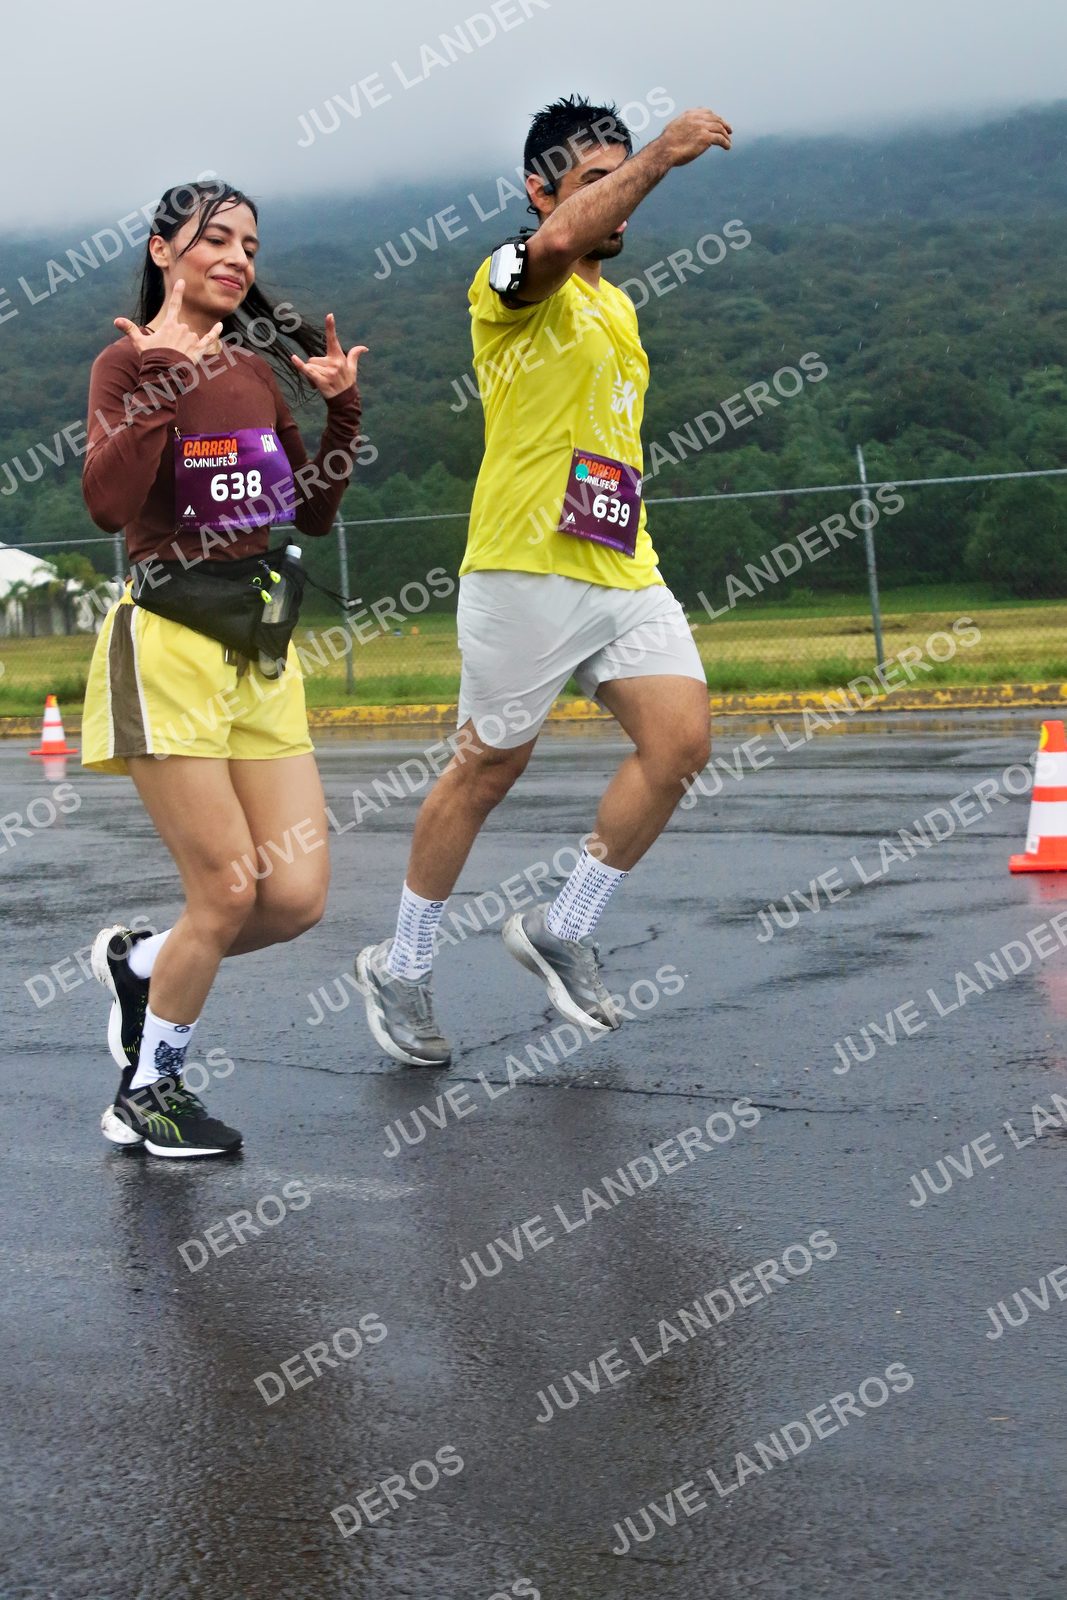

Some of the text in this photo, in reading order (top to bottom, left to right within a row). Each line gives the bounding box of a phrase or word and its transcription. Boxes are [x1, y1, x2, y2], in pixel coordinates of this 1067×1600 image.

[184, 438, 238, 456] CARRERA
[184, 457, 228, 468] OMNILIFE
[210, 470, 262, 502] 638
[592, 494, 630, 528] 639
